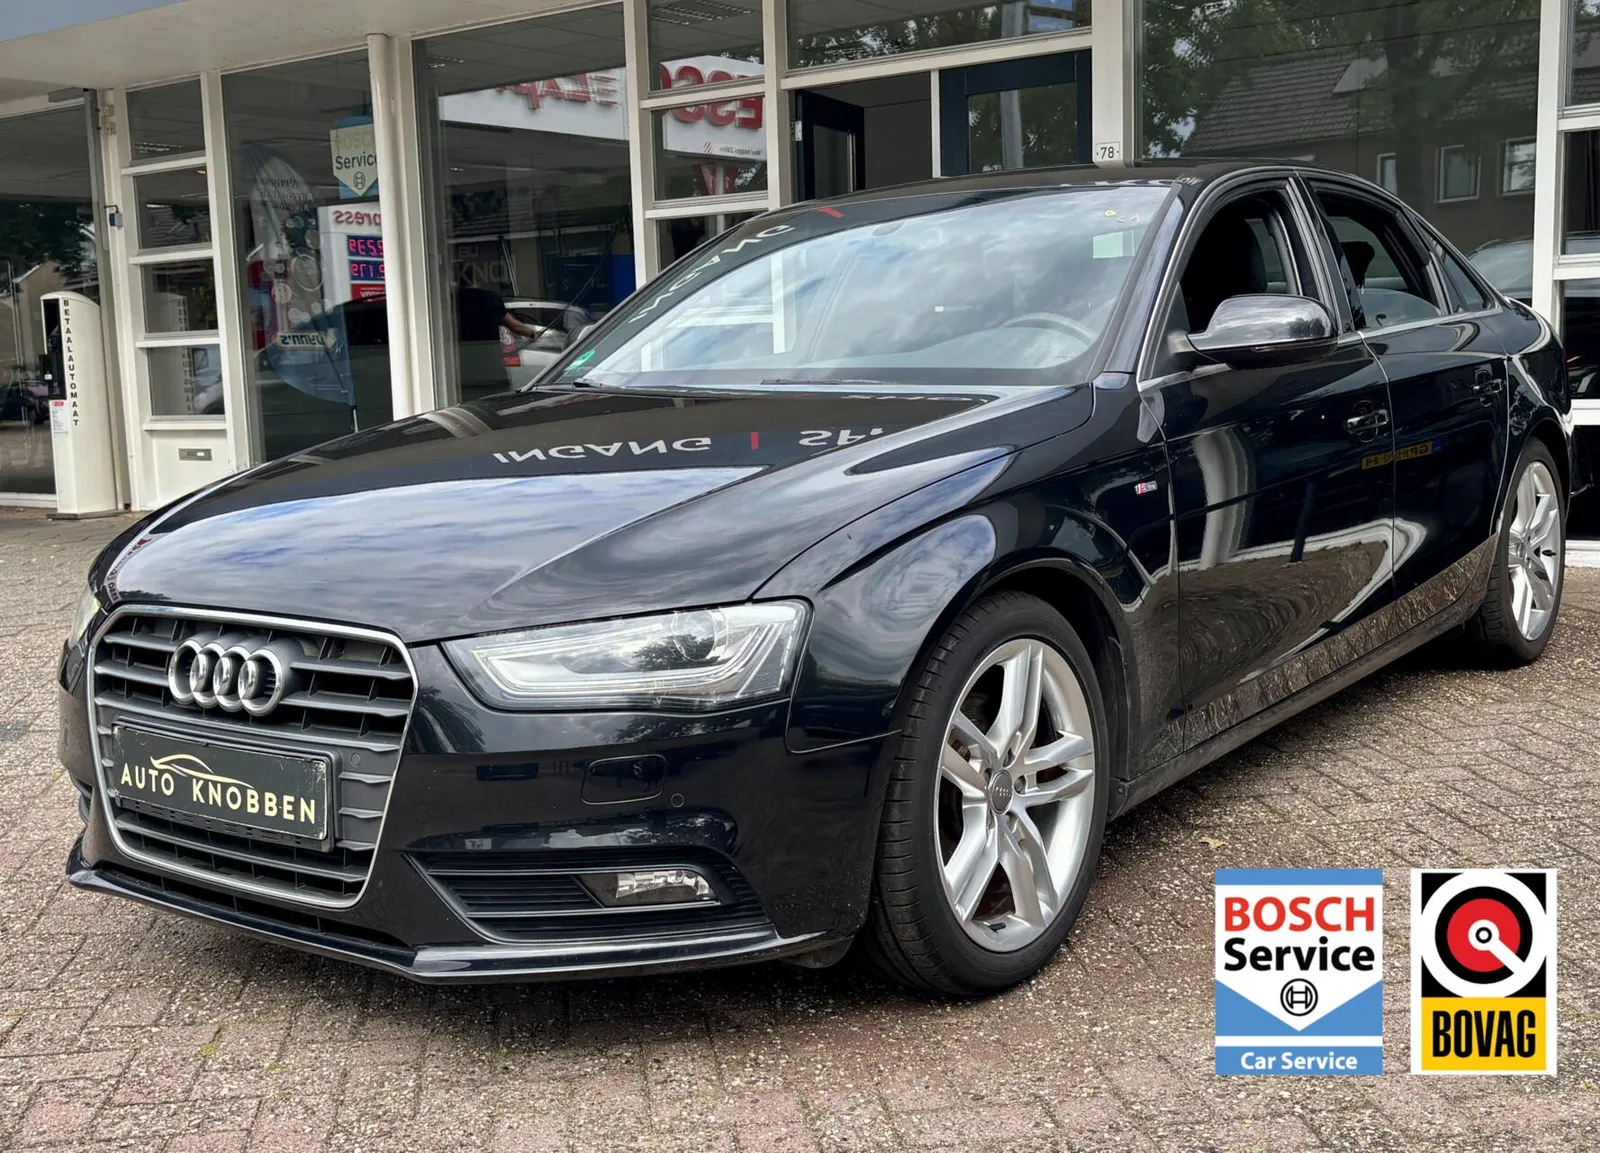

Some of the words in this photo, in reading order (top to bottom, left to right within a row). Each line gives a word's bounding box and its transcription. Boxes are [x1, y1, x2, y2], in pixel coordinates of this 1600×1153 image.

[335, 151, 378, 170] Servic
[63, 299, 79, 427] BETAALAUTOMAAT
[120, 762, 175, 796] AUTO
[192, 778, 316, 825] KNOBBEN
